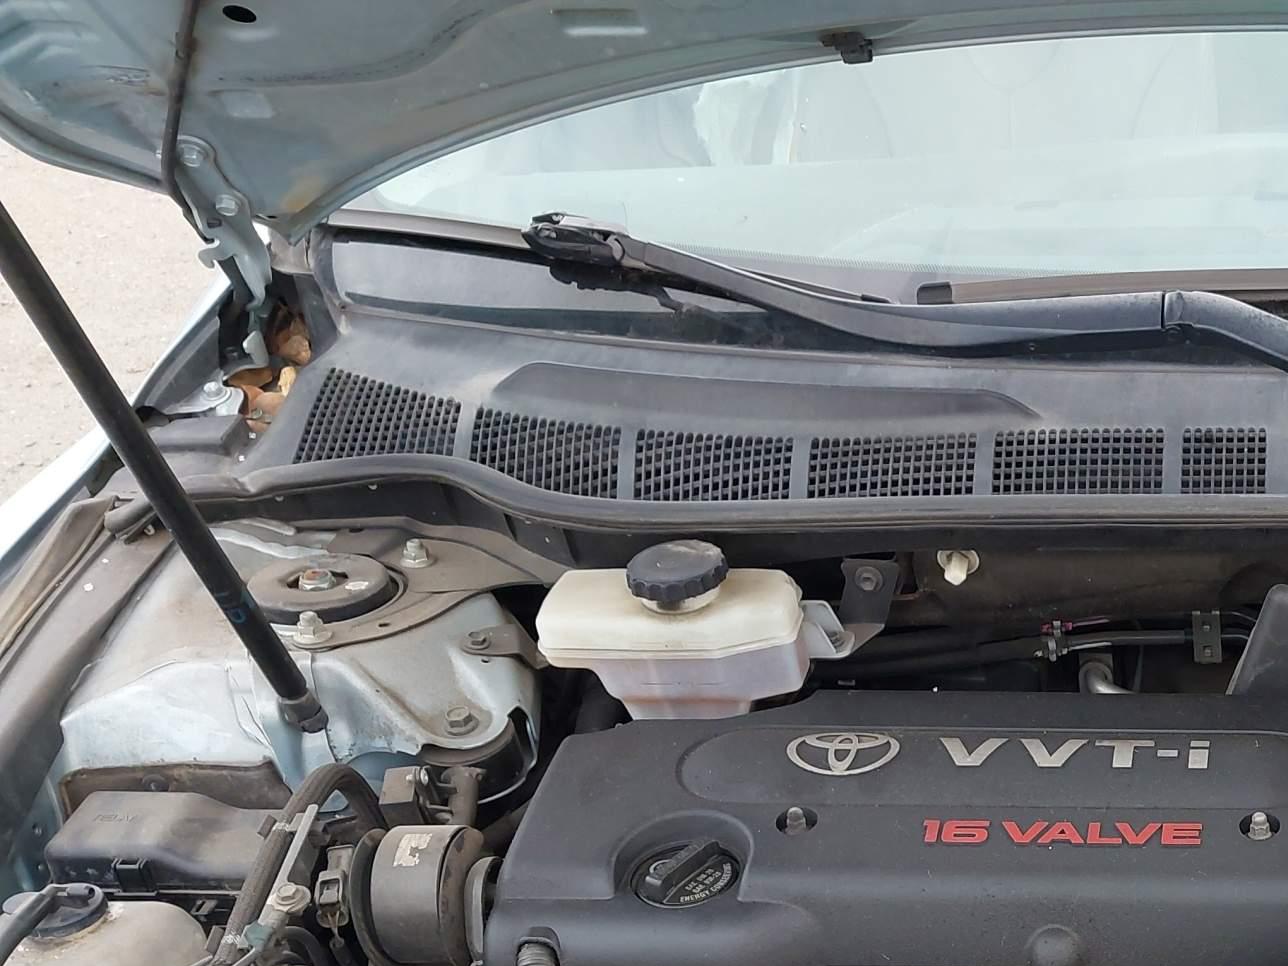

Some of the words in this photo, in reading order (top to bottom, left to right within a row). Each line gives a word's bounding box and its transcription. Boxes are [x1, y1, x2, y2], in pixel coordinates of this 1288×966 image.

[939, 737, 1210, 769] VVT-i
[923, 819, 991, 843] 16
[1002, 821, 1203, 845] VALVE
[680, 890, 711, 903] ENERGY
